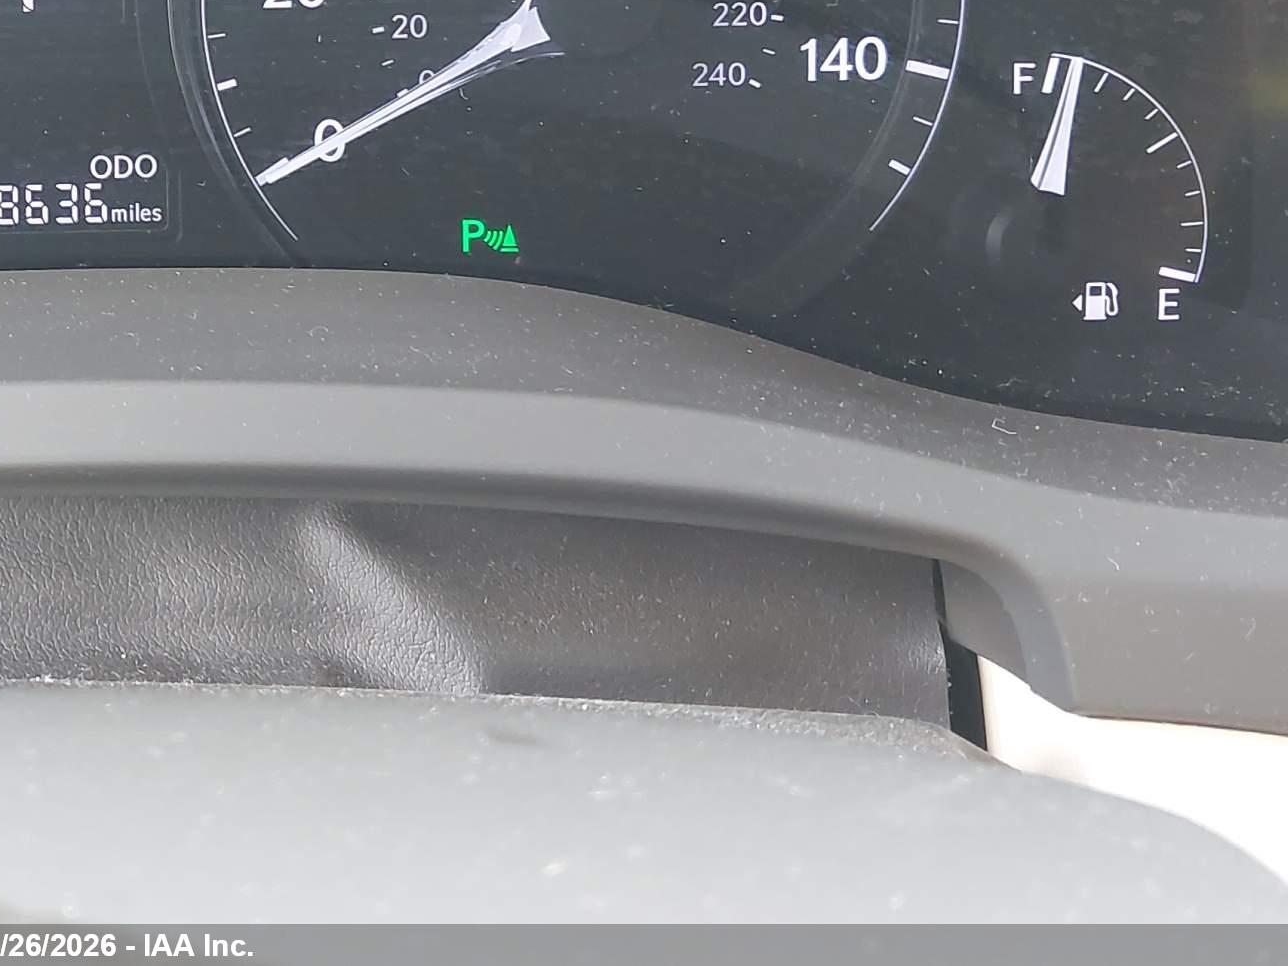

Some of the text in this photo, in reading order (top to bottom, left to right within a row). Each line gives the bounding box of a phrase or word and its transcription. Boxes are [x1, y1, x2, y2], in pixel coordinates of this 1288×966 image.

[391, 13, 428, 39] 20
[712, 1, 768, 27] 220
[798, 35, 888, 83] 140
[691, 62, 747, 88] 240
[1013, 62, 1037, 95] F
[89, 153, 159, 180] ODO
[111, 202, 163, 224] miles
[1158, 288, 1181, 321] E
